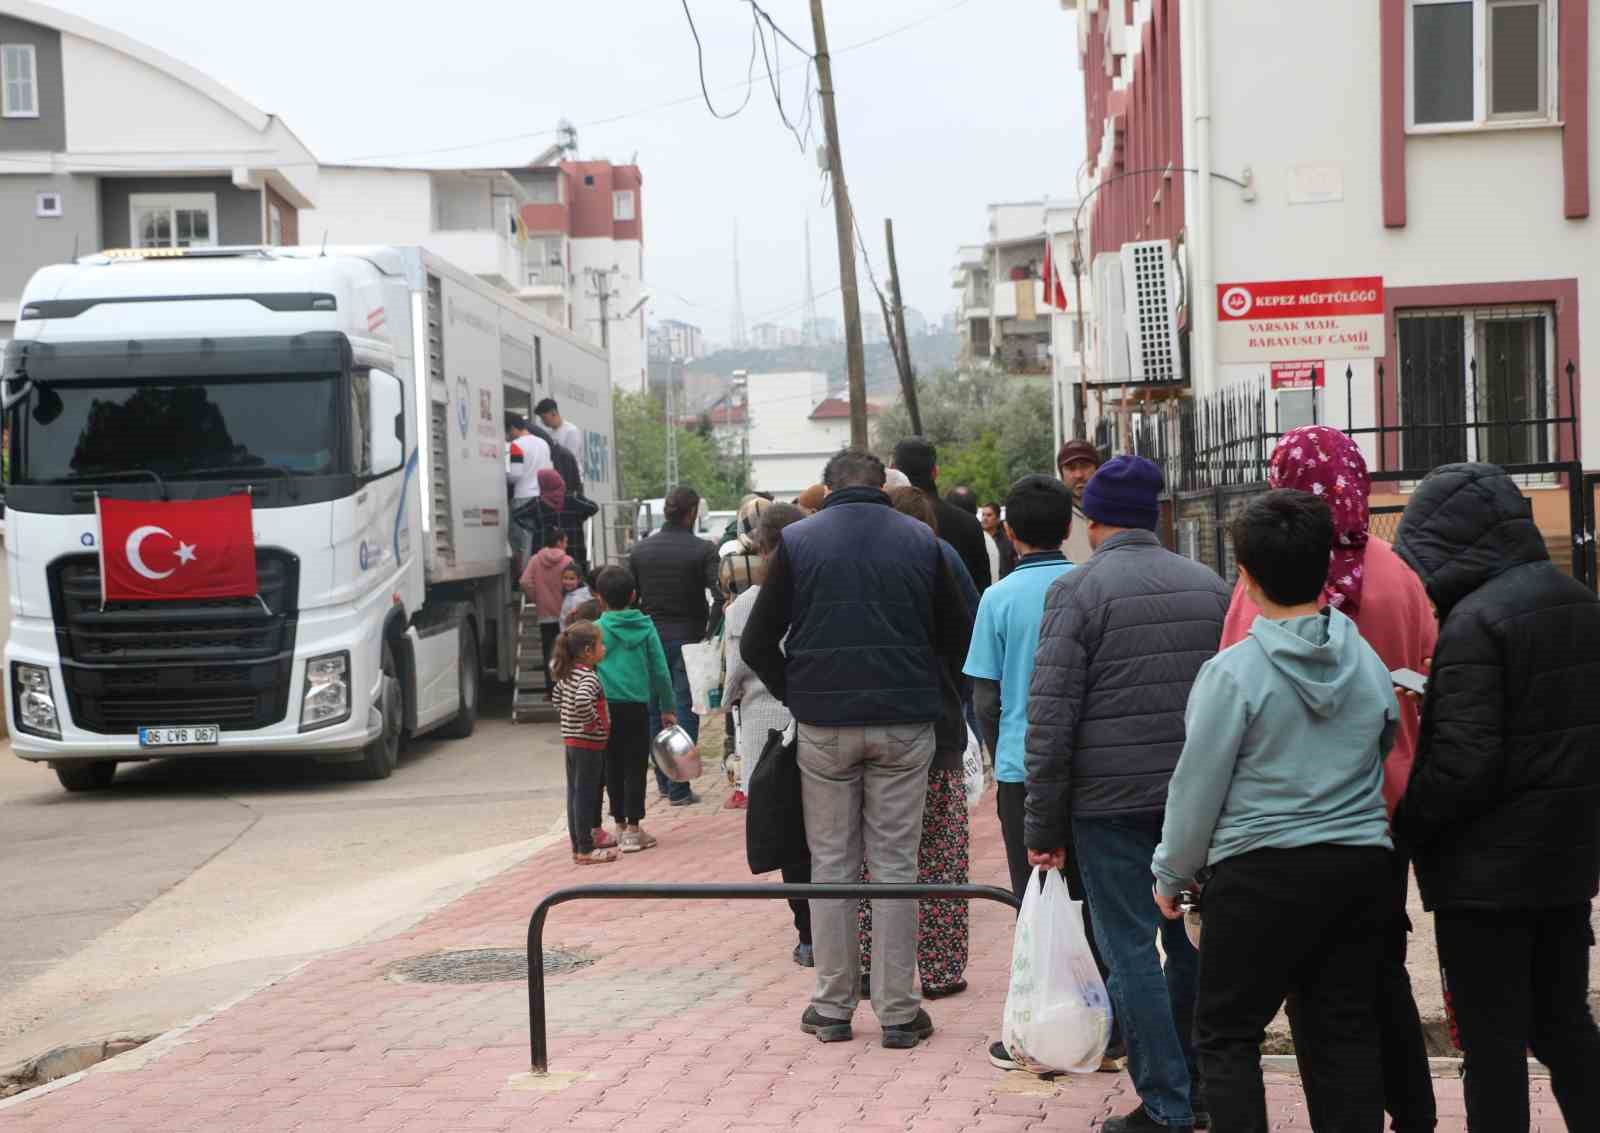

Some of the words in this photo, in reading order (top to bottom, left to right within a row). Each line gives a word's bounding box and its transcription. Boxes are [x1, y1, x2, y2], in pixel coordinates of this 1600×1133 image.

[1255, 294, 1296, 306] KEPEZ
[1248, 321, 1299, 333] VARSAK
[1303, 319, 1340, 331] MAH.
[1248, 335, 1323, 348] BABAYUSUF
